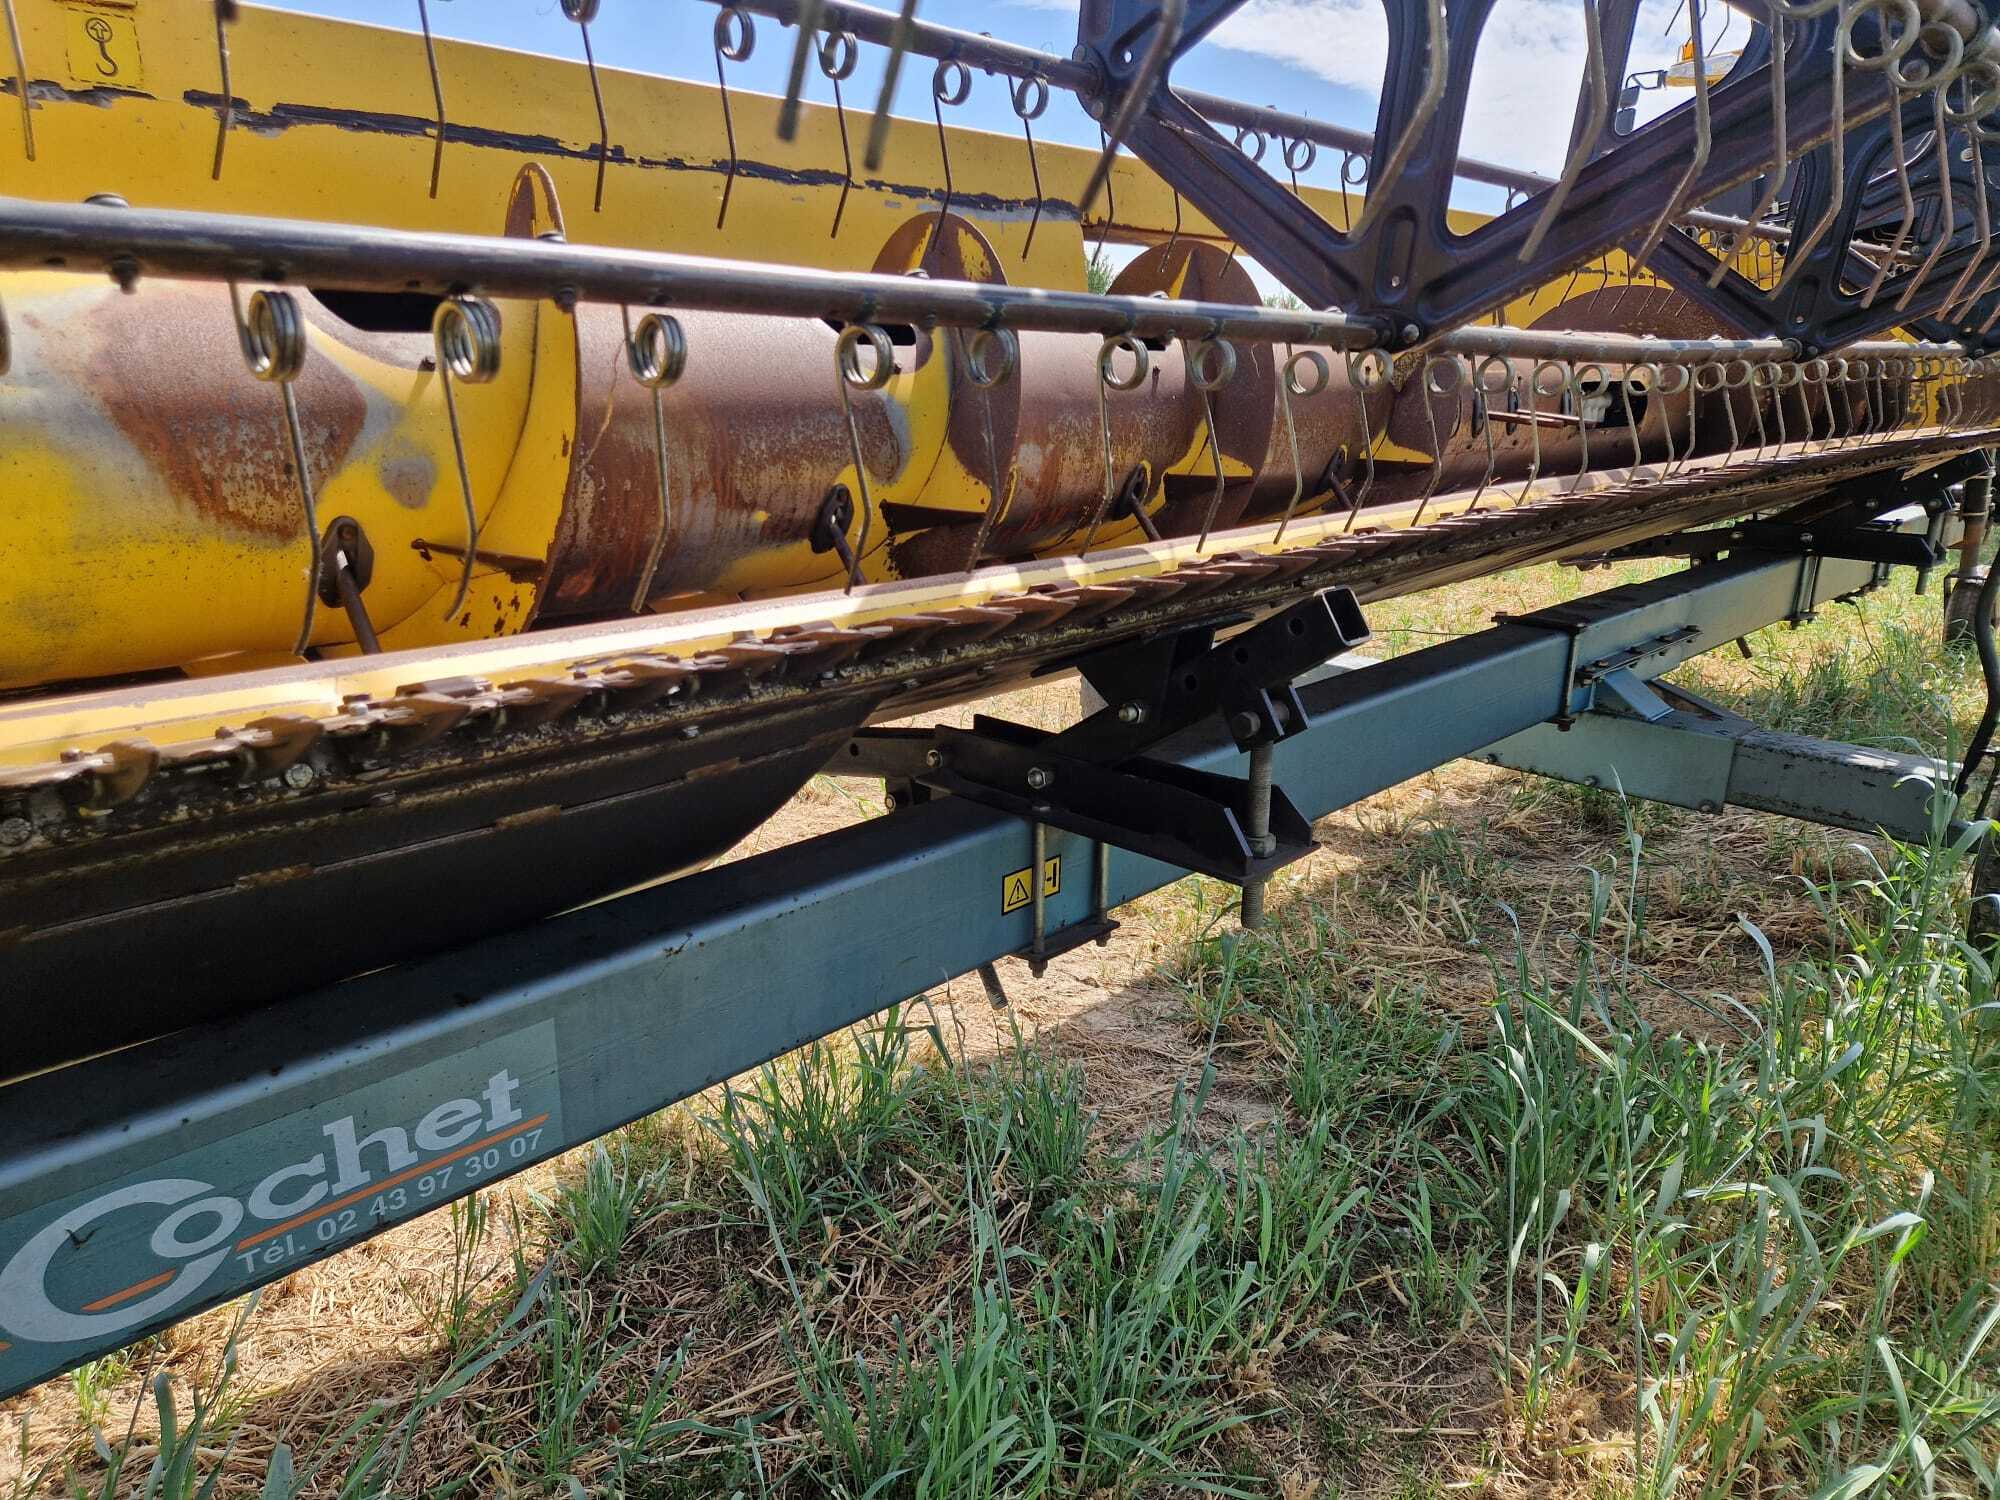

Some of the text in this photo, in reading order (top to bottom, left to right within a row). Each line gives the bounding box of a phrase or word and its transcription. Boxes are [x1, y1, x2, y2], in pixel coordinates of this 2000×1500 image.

[0, 1068, 523, 1342] Cochet
[235, 1128, 544, 1273] Tél. 02 43 97 30 07
